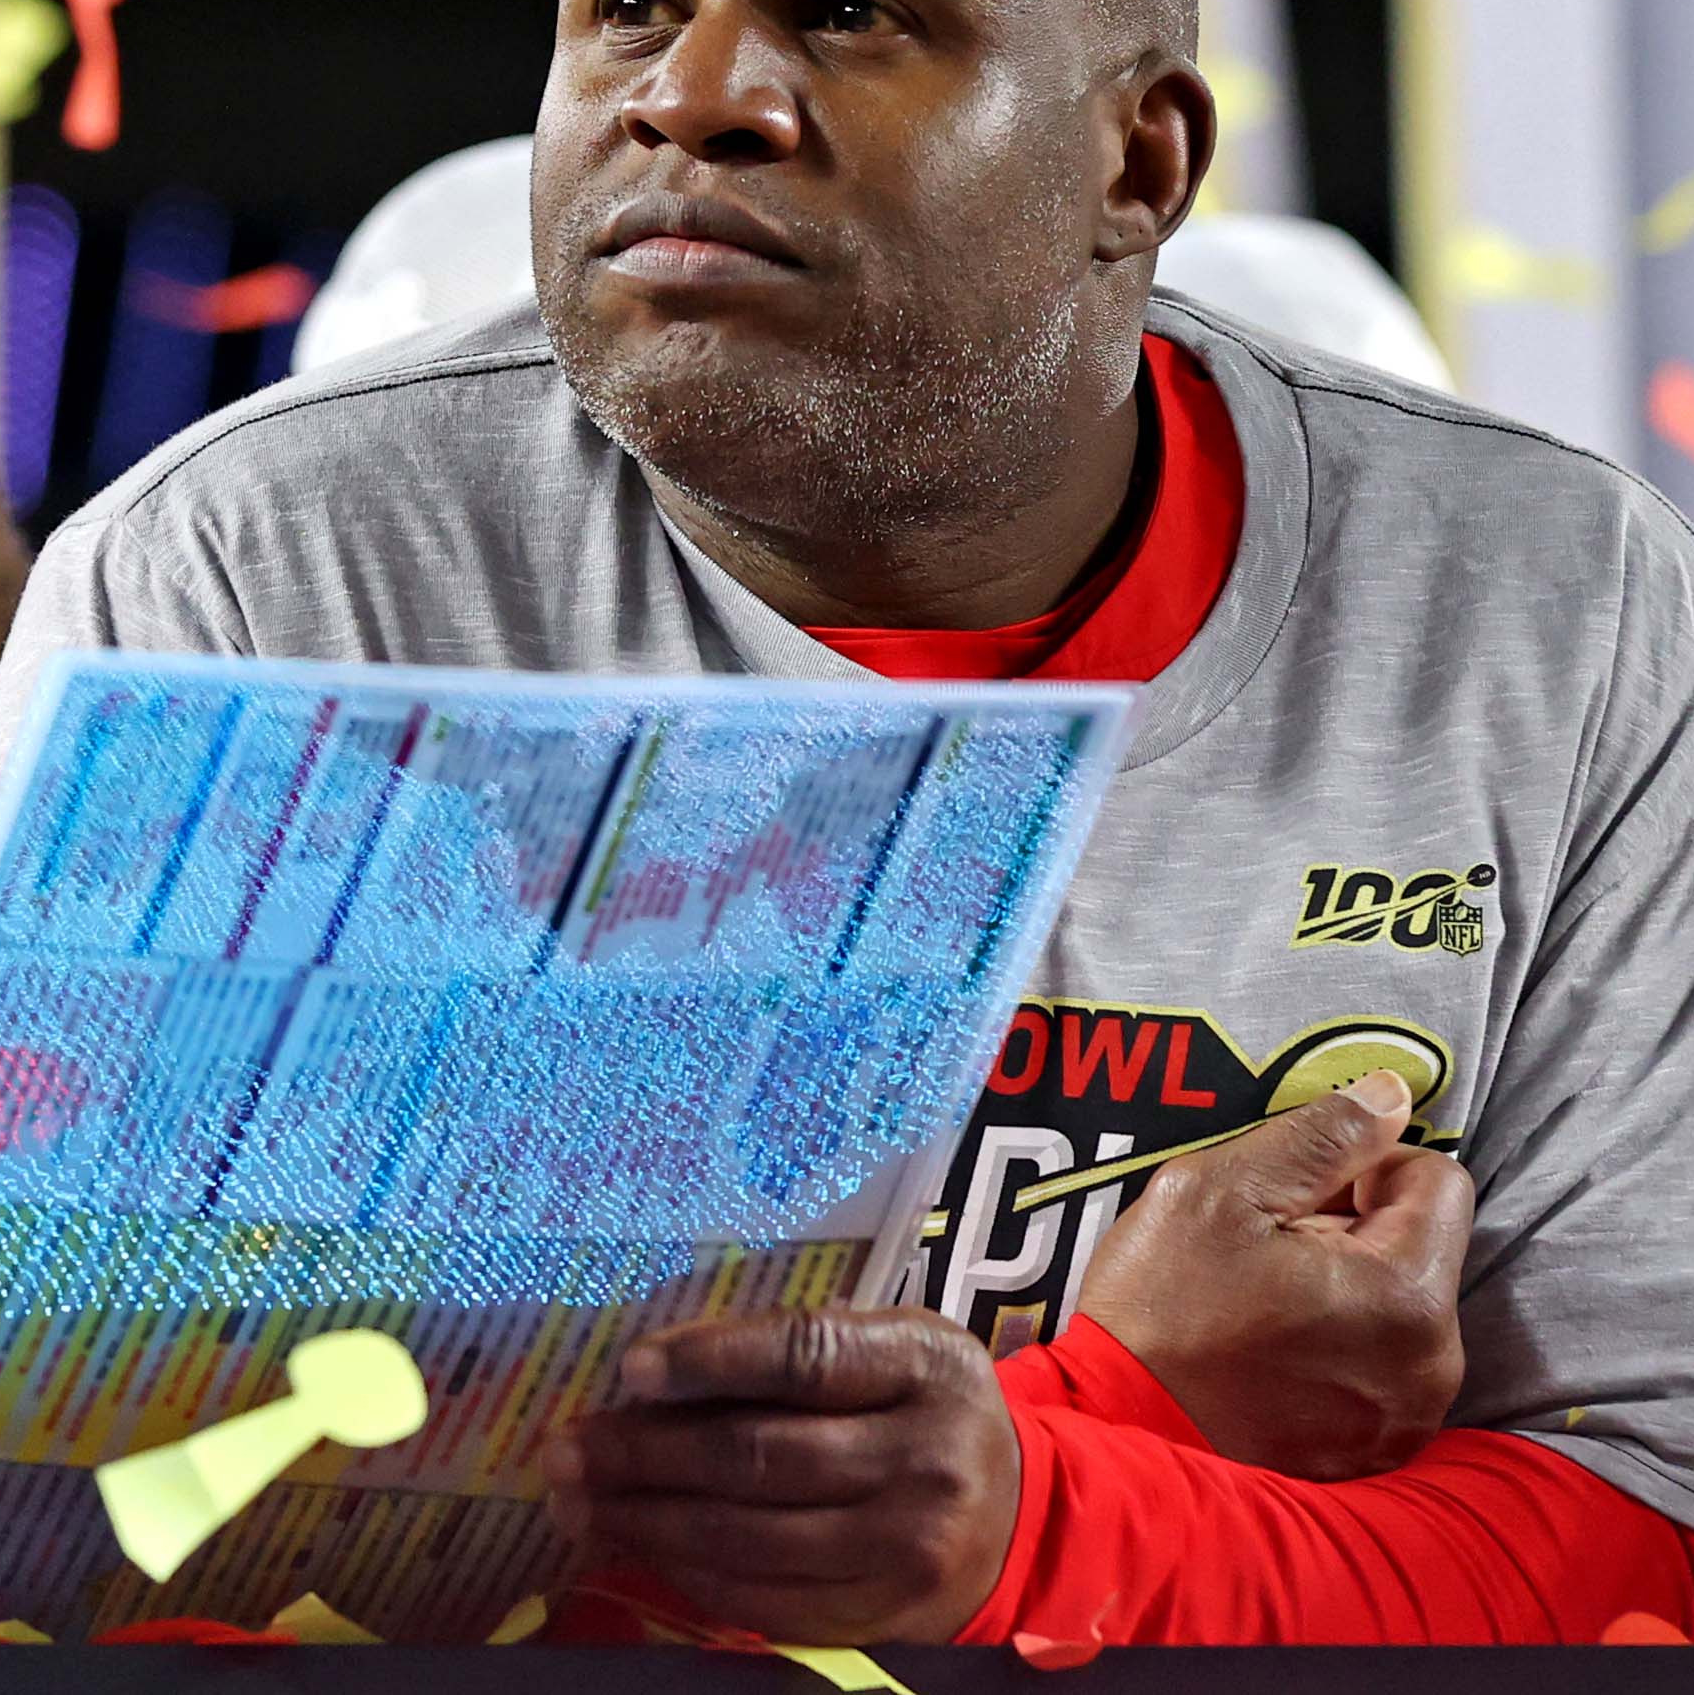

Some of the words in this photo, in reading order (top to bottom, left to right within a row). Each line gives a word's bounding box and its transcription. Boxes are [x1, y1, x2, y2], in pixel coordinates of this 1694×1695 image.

[1295, 867, 1457, 949] 100
[1443, 923, 1481, 949] NFL
[984, 1008, 1217, 1109] OWL
